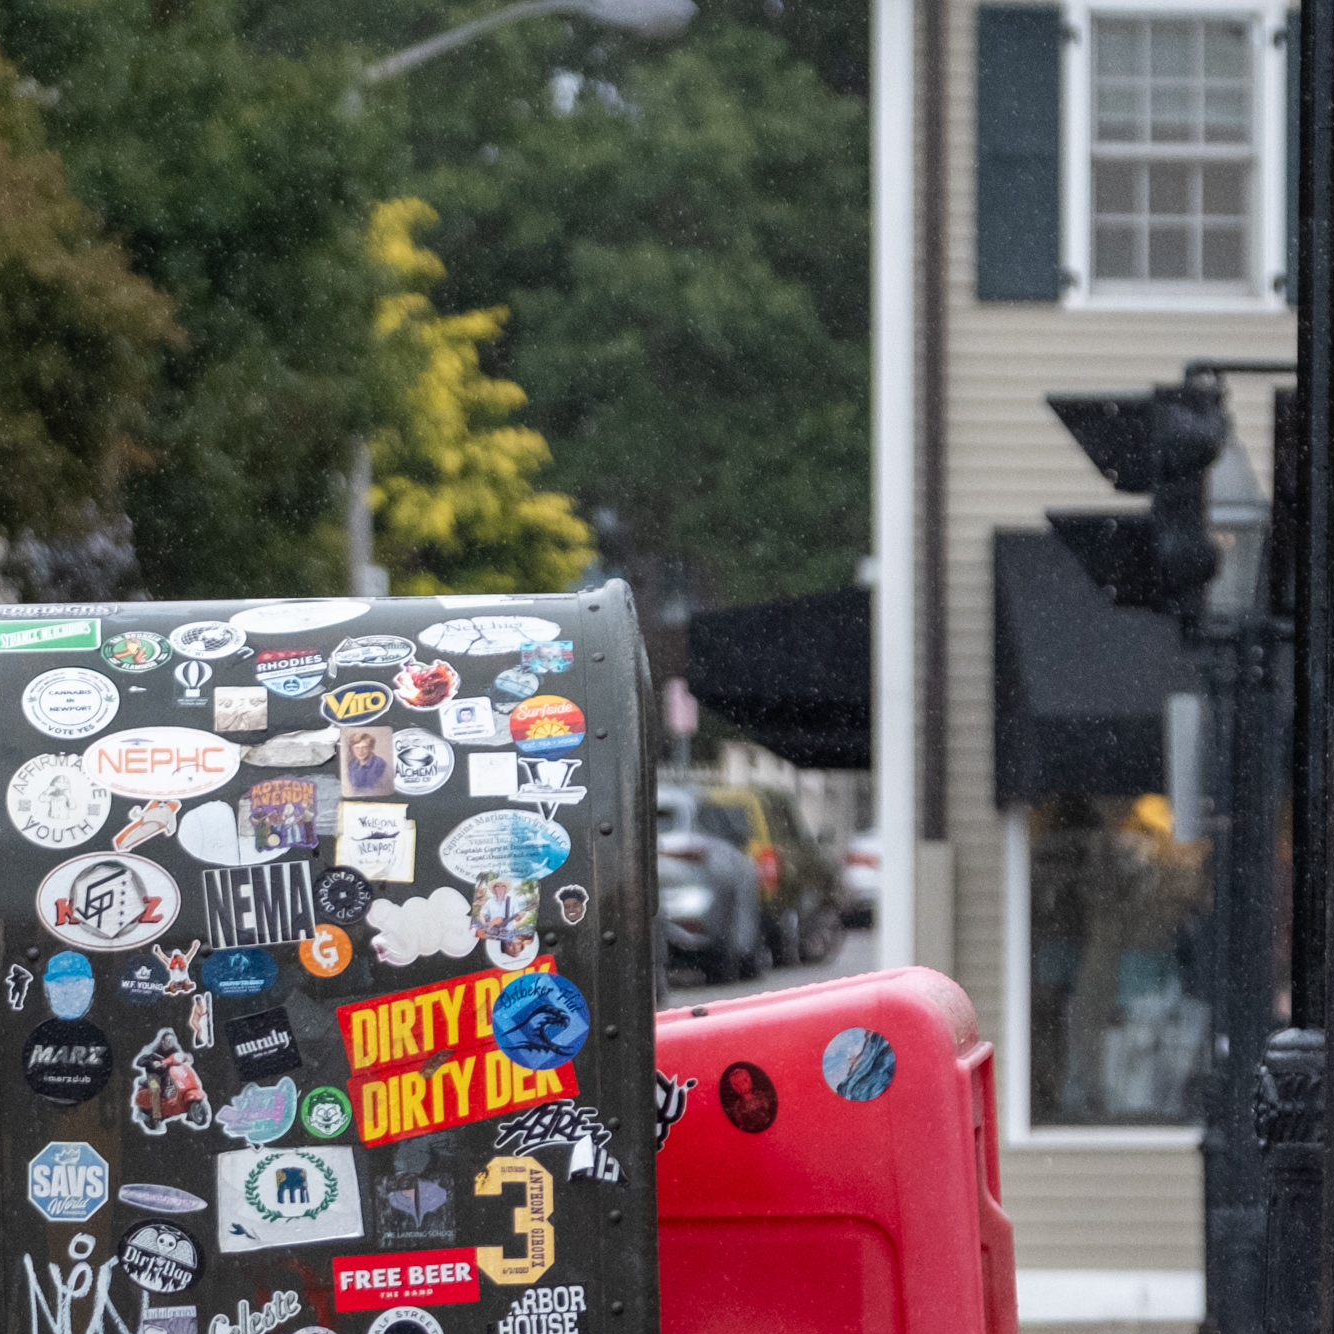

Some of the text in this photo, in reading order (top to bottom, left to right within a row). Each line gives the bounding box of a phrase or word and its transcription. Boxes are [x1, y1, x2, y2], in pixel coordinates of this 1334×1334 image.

[121, 660, 158, 670] FLAMINGO
[256, 653, 323, 672] RHODIES
[324, 690, 387, 720] VITO
[516, 701, 574, 721] Surfside
[47, 723, 96, 736] VOTE YES
[538, 739, 552, 747] TEA
[97, 747, 226, 774] NEPHC
[394, 760, 438, 778] ALCHEMY
[12, 752, 108, 800] AFFIRMAE
[252, 780, 314, 795] MOTION
[252, 791, 314, 808] AVENUE
[21, 815, 94, 843] YOUTH
[442, 823, 475, 856] Captains
[474, 812, 509, 826] Marine
[358, 840, 397, 855] NEWPORT
[204, 861, 315, 949] NEMA
[137, 981, 164, 991] YOUNG
[351, 984, 466, 1070] DIRTY
[28, 1044, 107, 1069] MARZ
[362, 1056, 477, 1142] DIRTY
[33, 1164, 104, 1198] SAVS
[529, 1168, 545, 1268] ANTHONY GIROUX
[428, 1229, 455, 1237] SCHOOL
[340, 1262, 473, 1291] FREE BEER
[379, 1288, 434, 1299] THE BAND
[395, 1310, 437, 1334] STREET
